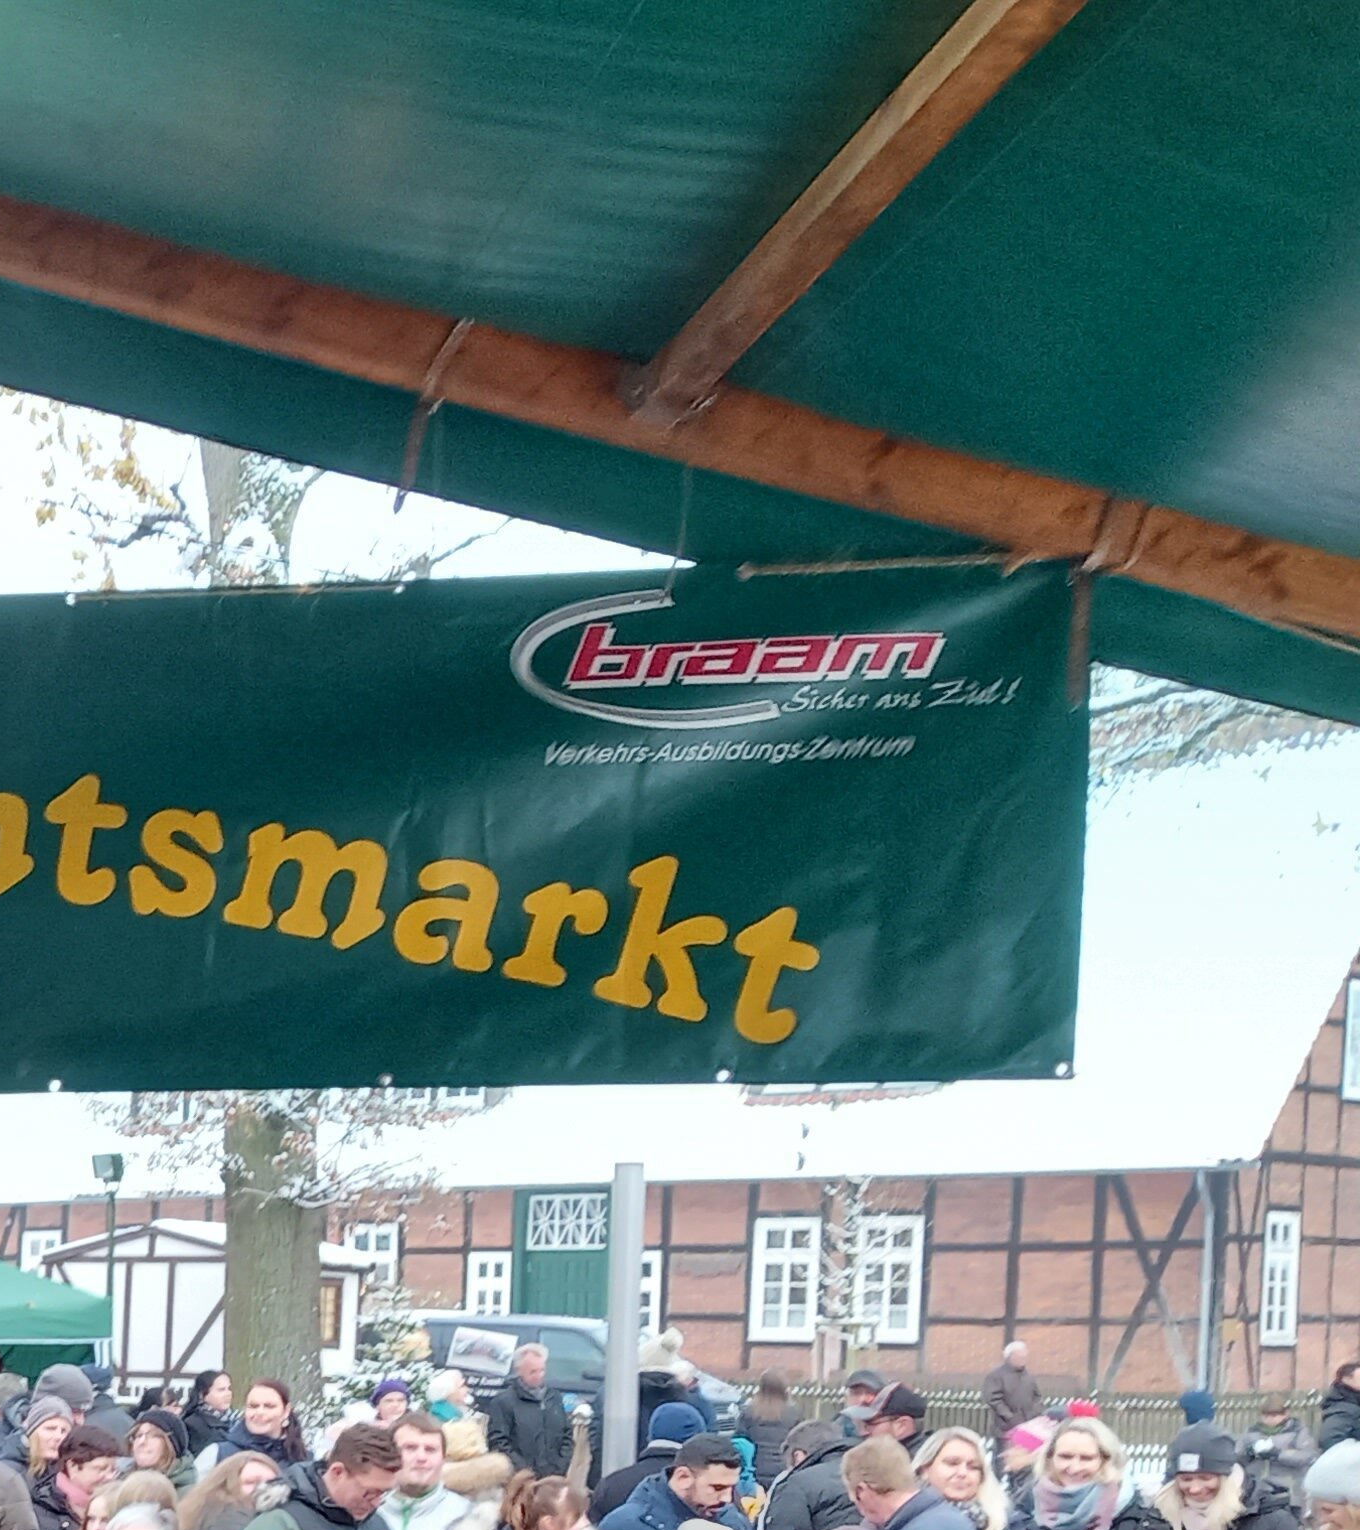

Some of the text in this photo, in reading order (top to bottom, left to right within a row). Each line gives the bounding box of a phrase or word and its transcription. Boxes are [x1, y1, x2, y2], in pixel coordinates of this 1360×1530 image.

[562, 621, 947, 689] braam
[780, 684, 870, 713] Sicher
[872, 690, 923, 710] ans
[543, 735, 917, 767] Verkehrs-Ausbildungs-Zentrum
